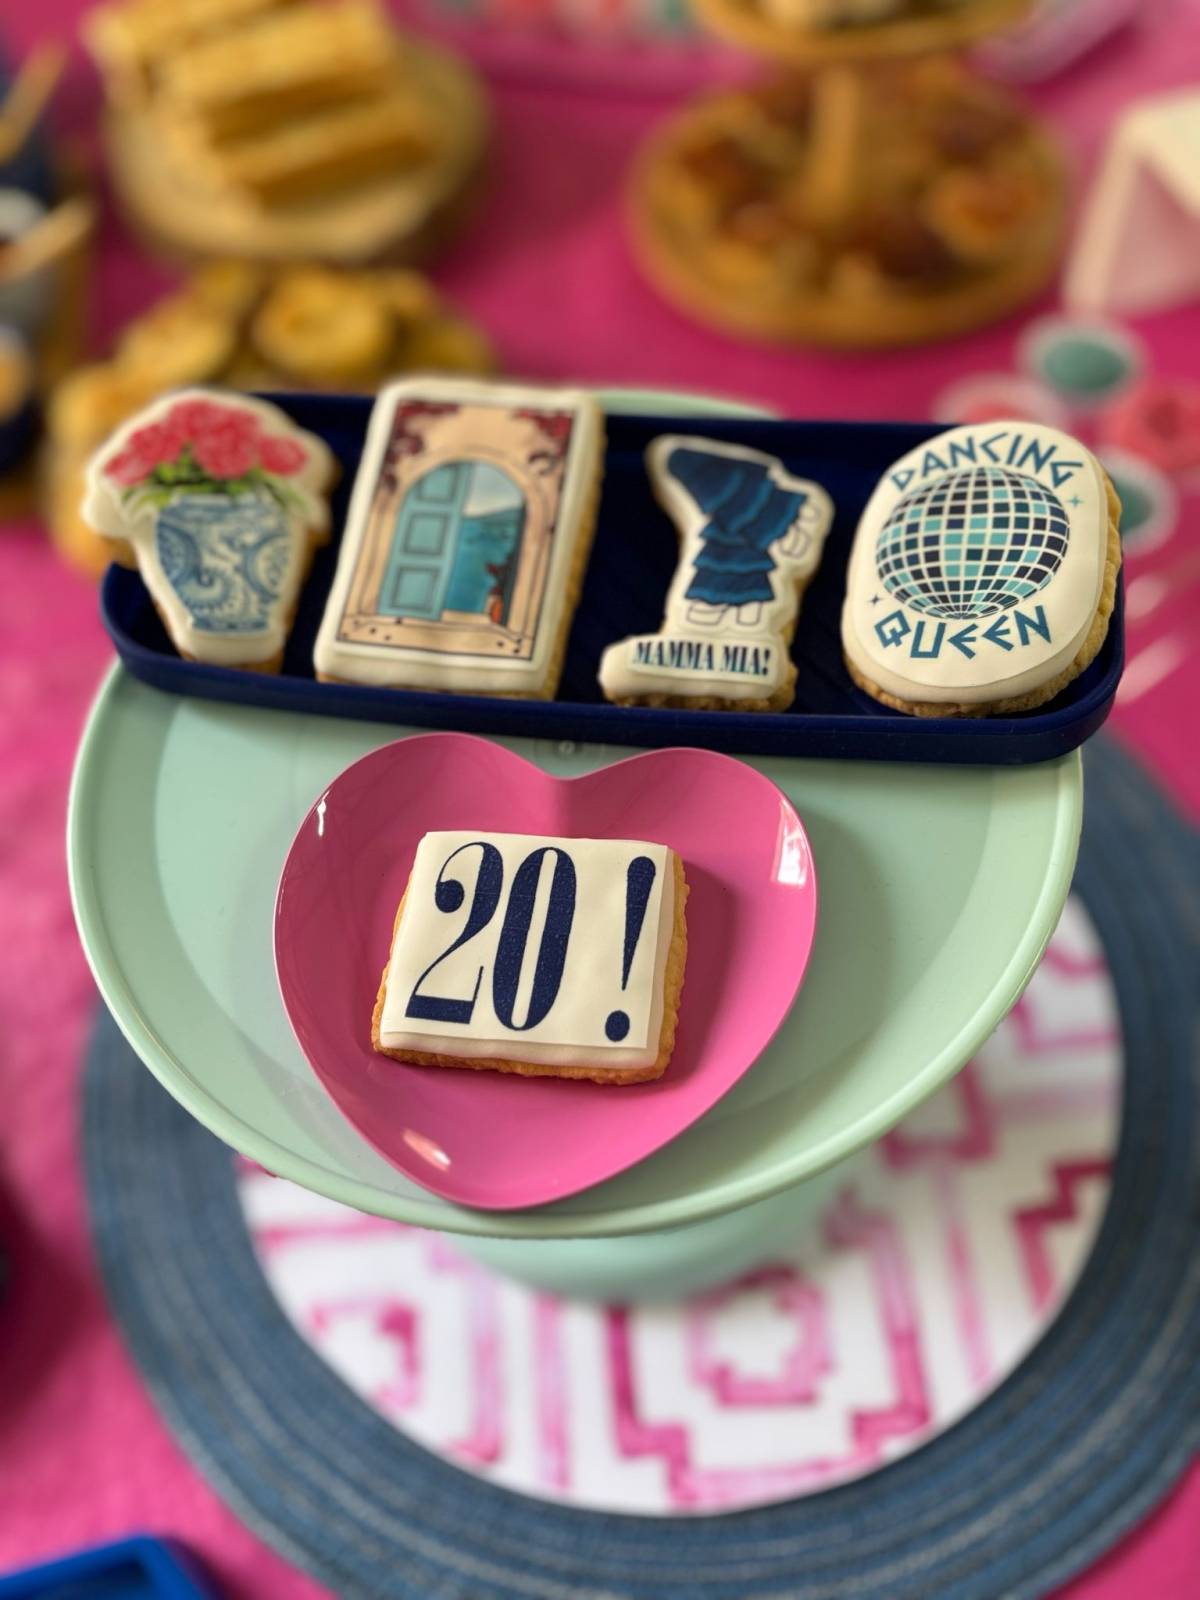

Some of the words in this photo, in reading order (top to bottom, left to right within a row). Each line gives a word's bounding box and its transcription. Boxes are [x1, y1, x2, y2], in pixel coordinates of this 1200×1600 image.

[891, 432, 1084, 491] DANCING
[633, 641, 714, 671] MAMMA
[719, 645, 771, 677] MIA!
[874, 605, 1051, 660] QUEEN
